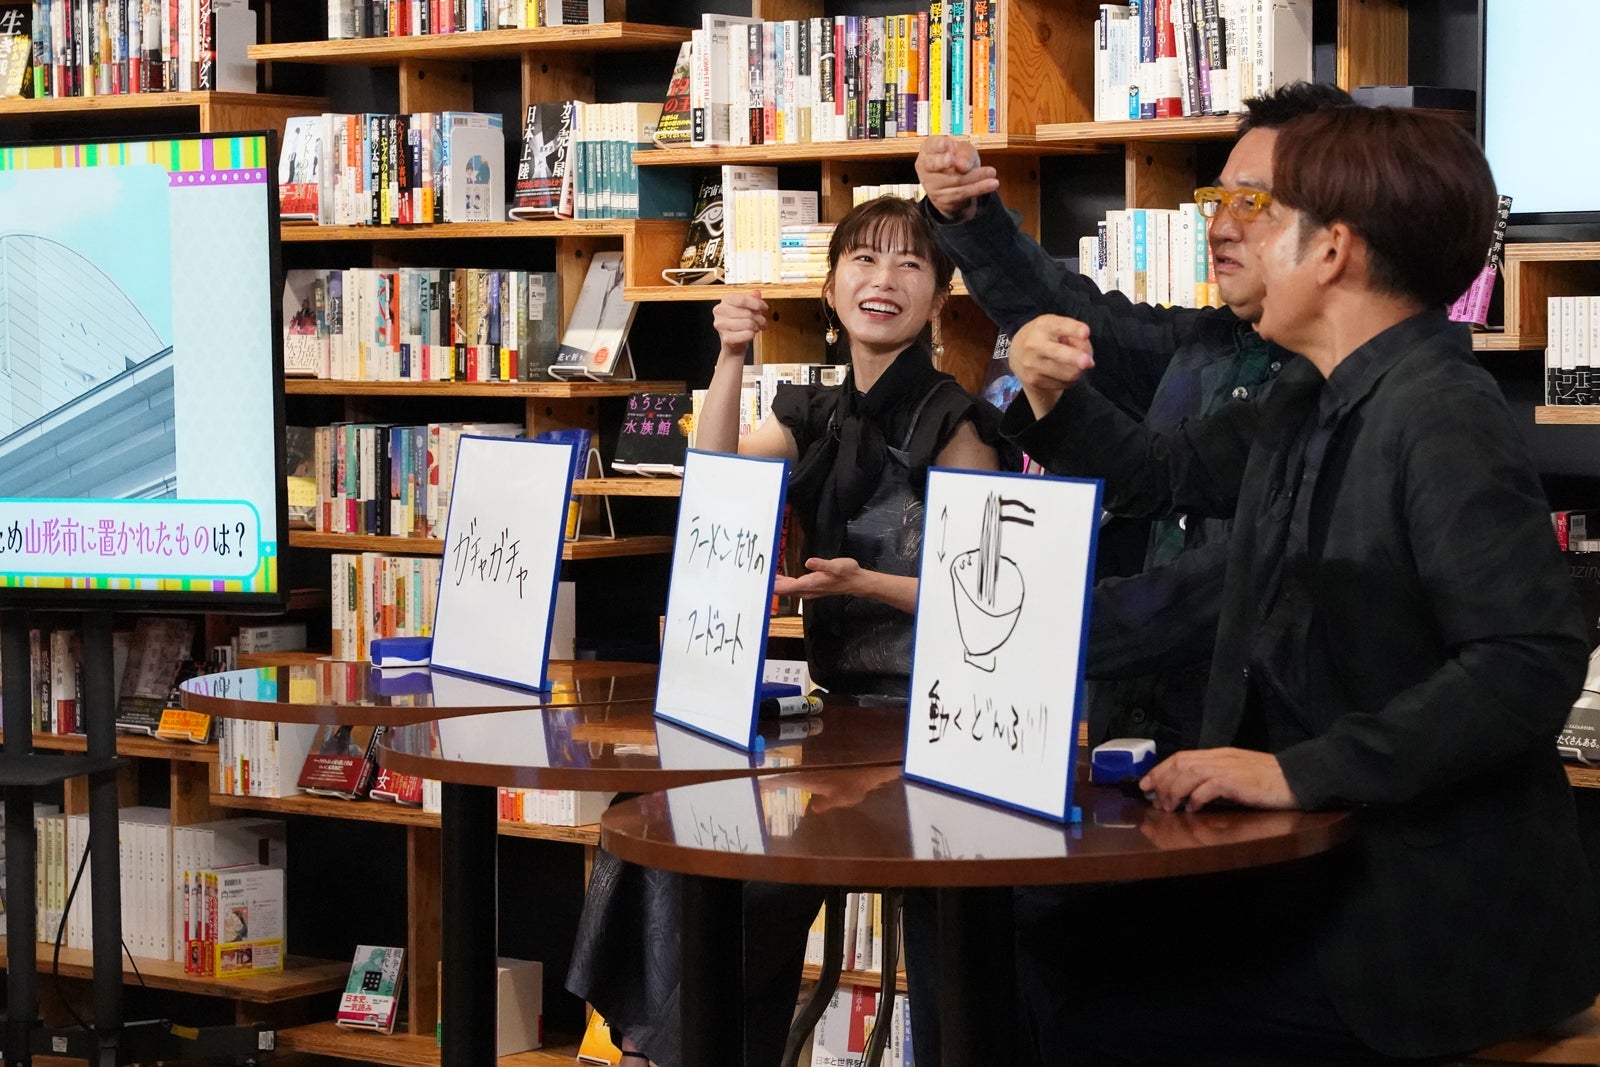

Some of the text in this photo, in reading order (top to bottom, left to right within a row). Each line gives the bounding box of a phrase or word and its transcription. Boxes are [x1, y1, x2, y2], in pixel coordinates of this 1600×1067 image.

[517, 105, 537, 180] 日本上陸
[552, 101, 573, 178] カラ売り屋
[629, 396, 676, 411] もうどく
[623, 420, 672, 436] 水族館
[453, 517, 529, 599] ガチャガチャ
[690, 515, 765, 575] ラーメンだけの
[687, 609, 744, 666] フードコート
[927, 680, 1049, 764] 動くどんぶり
[1556, 733, 1600, 748] たくさんある。
[376, 769, 391, 790] 女
[344, 1003, 373, 1013] 一気読み
[345, 994, 368, 1004] 日本史、
